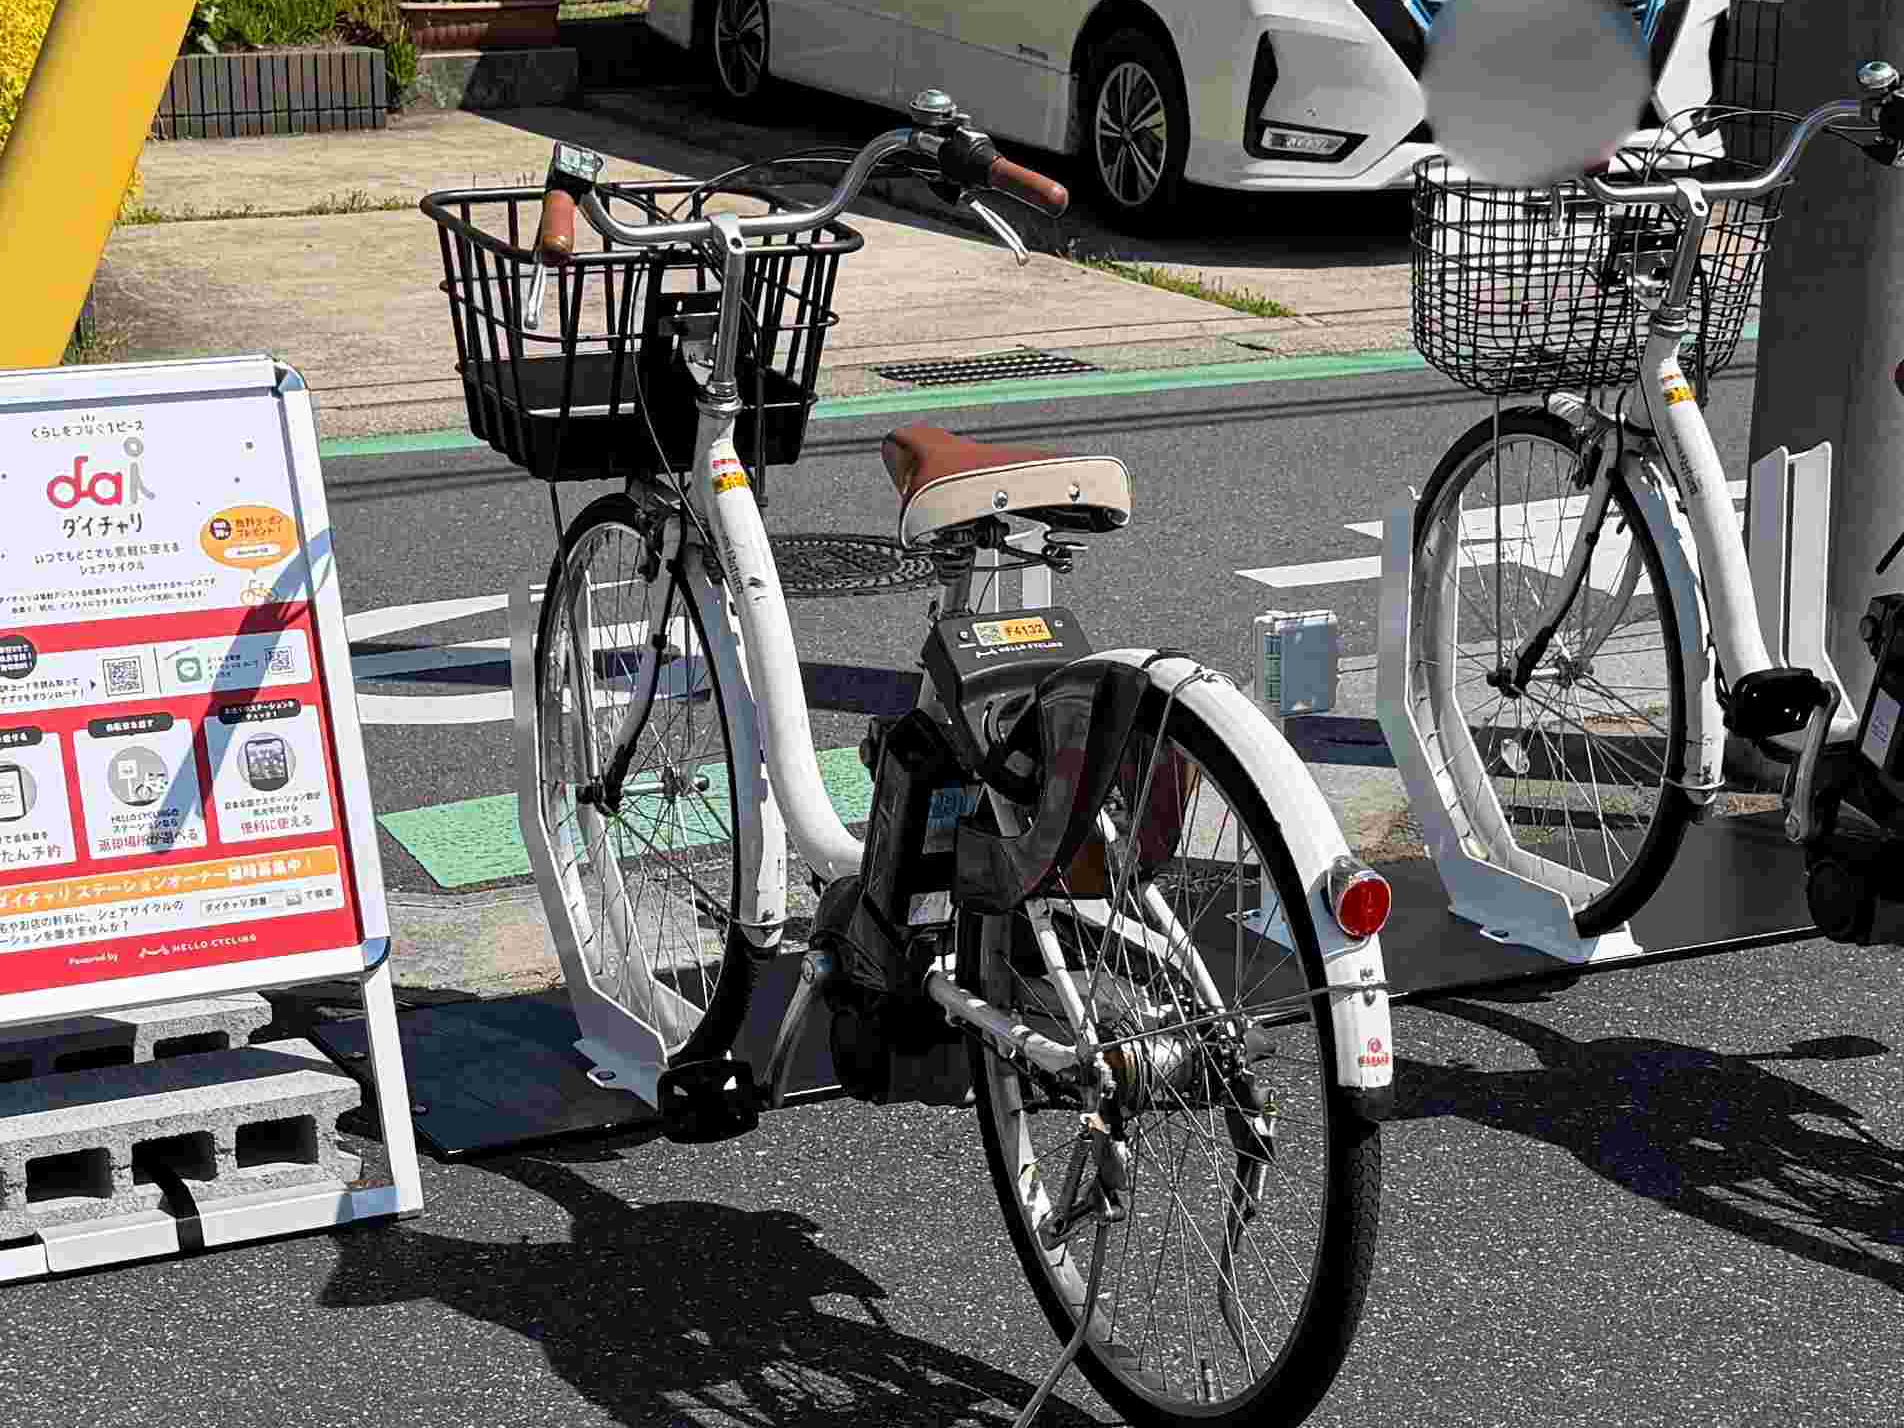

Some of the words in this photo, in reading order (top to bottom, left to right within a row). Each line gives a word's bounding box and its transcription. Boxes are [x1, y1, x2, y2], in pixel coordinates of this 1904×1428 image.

[63, 513, 143, 538] ダイチャリ
[34, 542, 180, 564] いつでもどこでも気軽に使える
[79, 560, 145, 576] シェアサイクル
[240, 815, 313, 835] 便利に使える
[172, 940, 209, 954] HELLO
[210, 933, 257, 948] CYCLING
